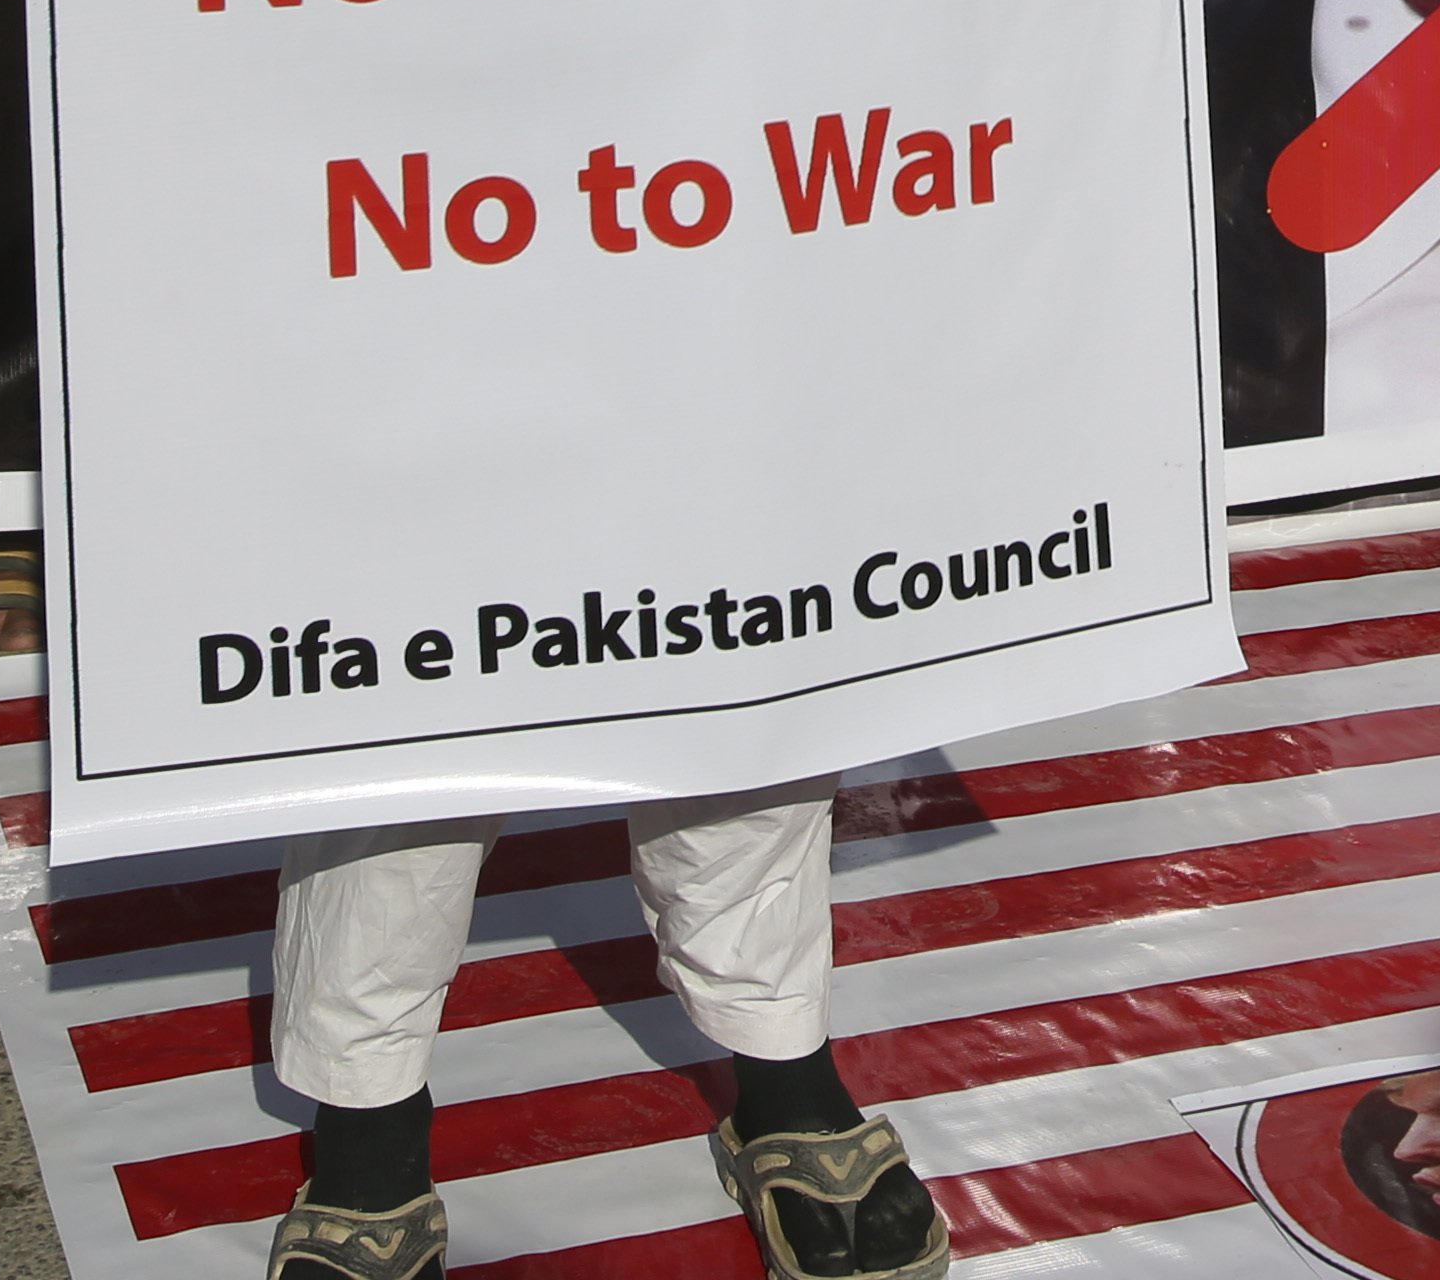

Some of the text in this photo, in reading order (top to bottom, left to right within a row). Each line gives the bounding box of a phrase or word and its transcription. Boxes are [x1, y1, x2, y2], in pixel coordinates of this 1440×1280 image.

[327, 107, 1013, 279] No to War
[200, 503, 1112, 705] Difa e Pakistan Council
